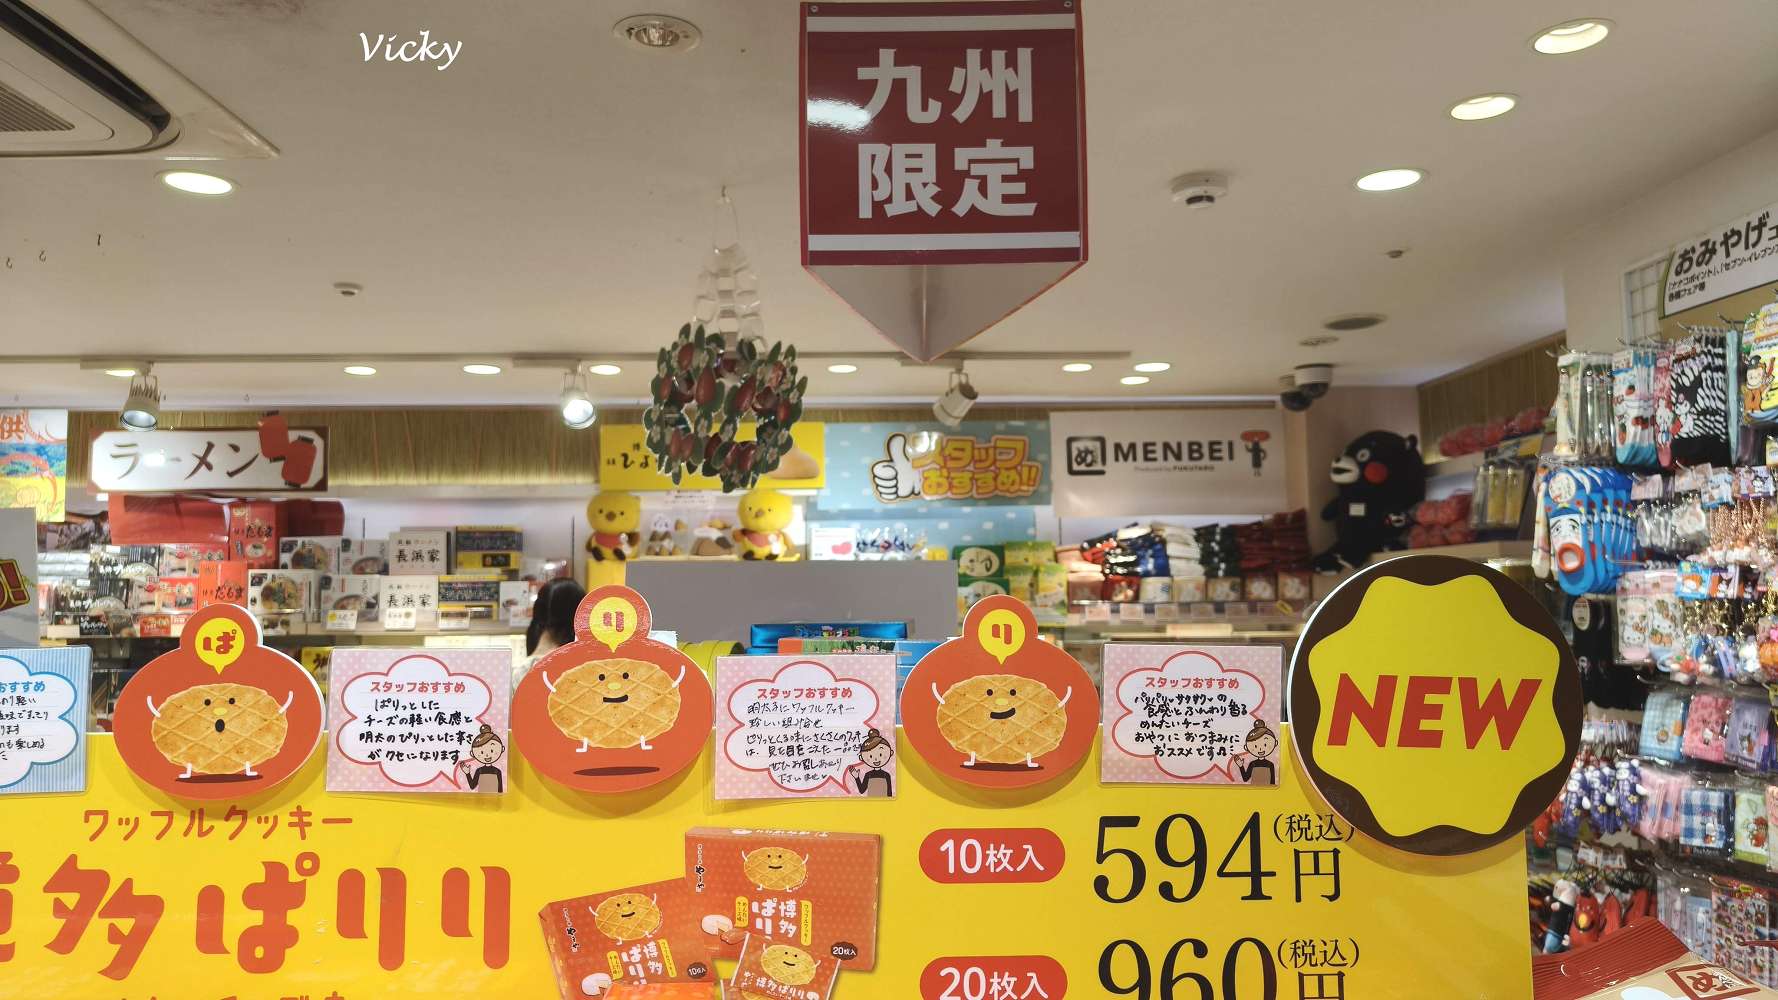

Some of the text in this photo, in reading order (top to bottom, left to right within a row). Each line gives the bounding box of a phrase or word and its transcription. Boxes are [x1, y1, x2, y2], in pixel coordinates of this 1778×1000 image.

[857, 48, 1035, 124] 九州
[858, 139, 1038, 219] 限定
[1113, 440, 1234, 462] MENBEI
[603, 611, 625, 632] り
[992, 623, 1012, 645] り
[203, 629, 237, 654] ぱ
[370, 681, 466, 693] スタッフおすすめ
[757, 687, 853, 699] スタッフおすすめ
[1145, 677, 1240, 689] スタッフおすすめ
[1327, 673, 1543, 750] NEW
[83, 804, 354, 842] ワッフルクッキー
[939, 838, 1045, 874] 10枚入
[1093, 811, 1277, 904] 594
[1293, 847, 1342, 903] 円
[751, 898, 778, 941] ぱり
[1098, 937, 1278, 1000] 960
[1277, 937, 1360, 969] (税込)
